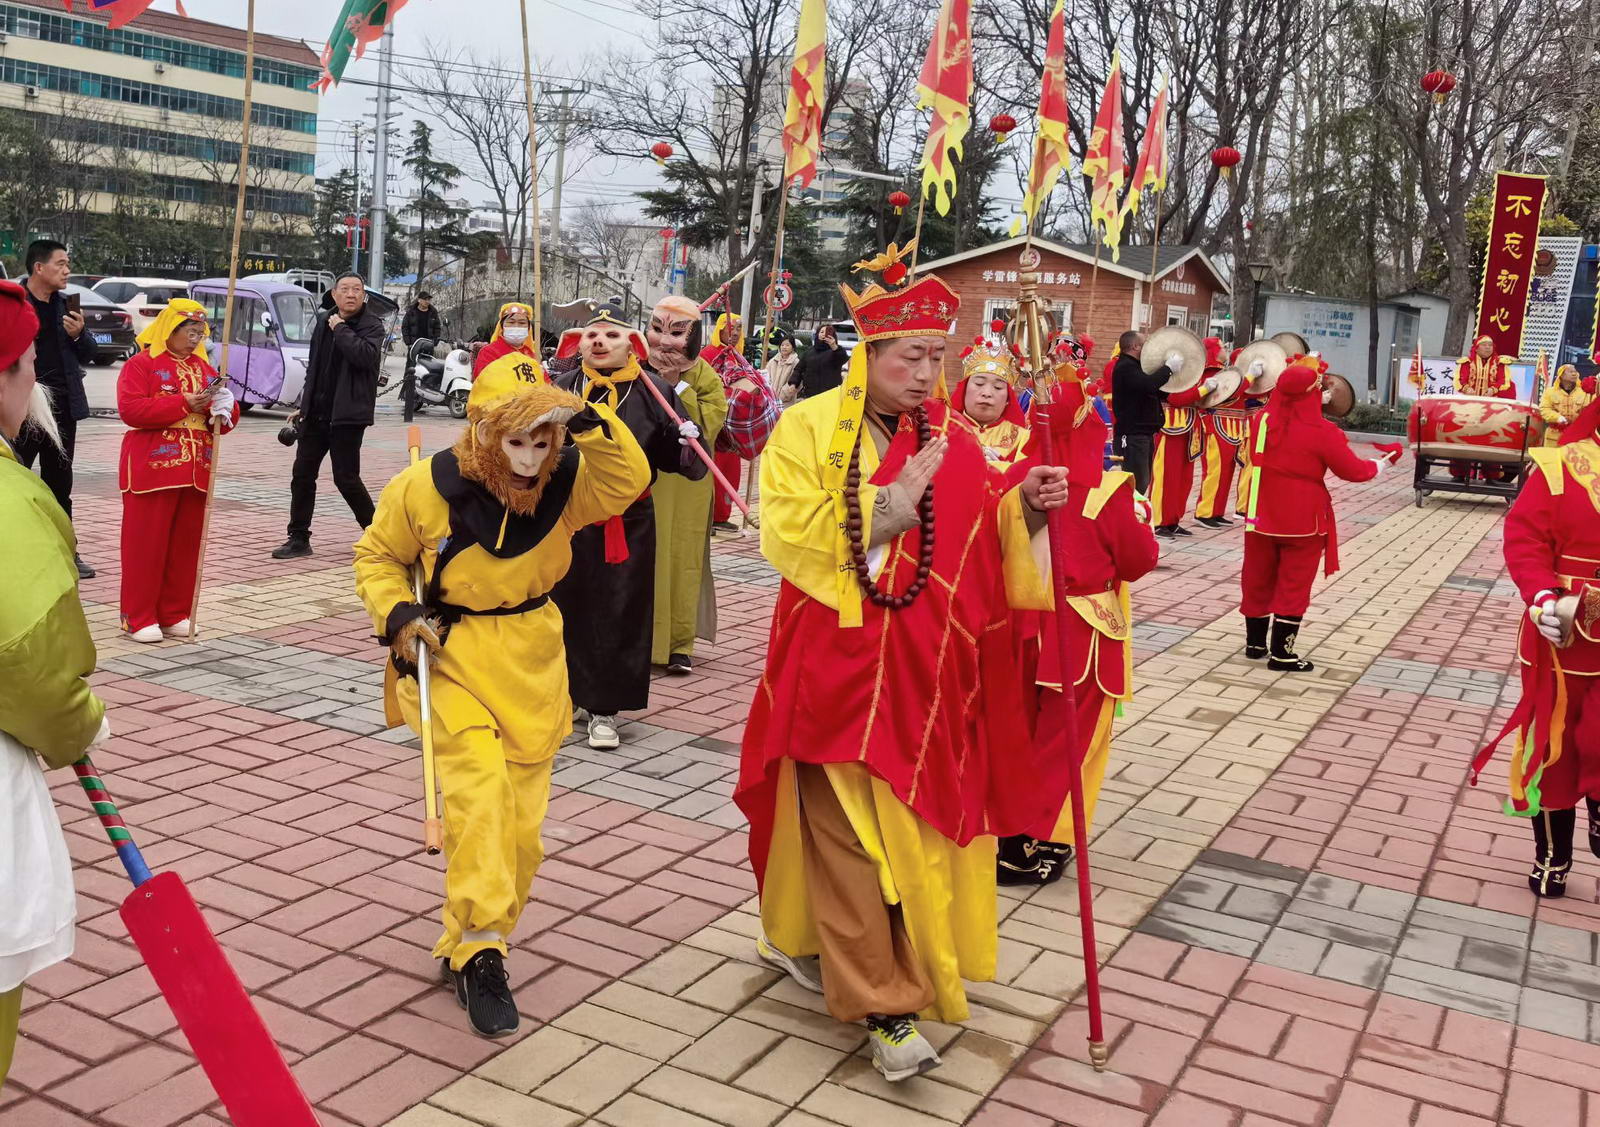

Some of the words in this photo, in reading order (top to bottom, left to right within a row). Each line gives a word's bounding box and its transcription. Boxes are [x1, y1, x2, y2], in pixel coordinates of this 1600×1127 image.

[1490, 195, 1532, 332] 不忘初心
[982, 270, 1081, 285] 学雷锋服务站
[512, 362, 537, 384] 佛
